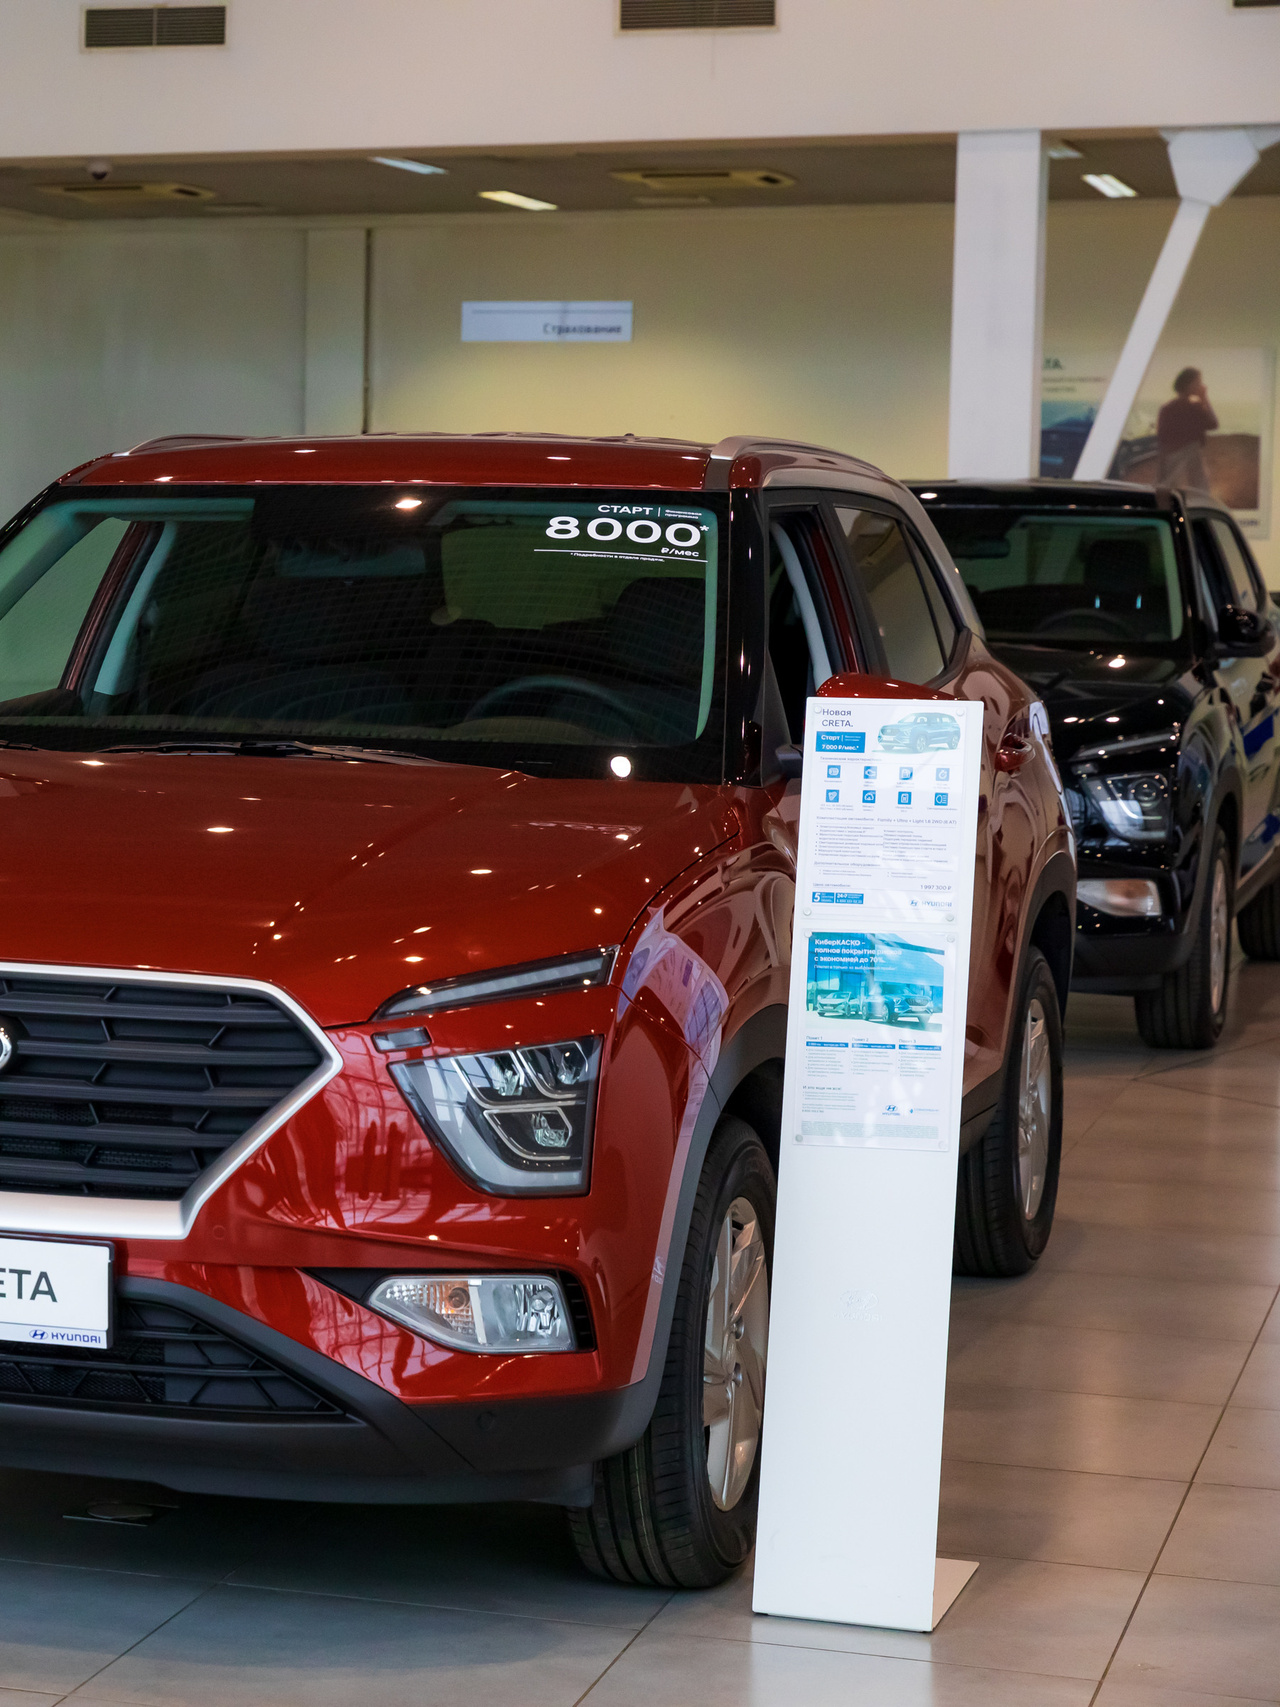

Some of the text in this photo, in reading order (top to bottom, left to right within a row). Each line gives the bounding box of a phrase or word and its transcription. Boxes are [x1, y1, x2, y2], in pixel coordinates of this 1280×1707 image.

[597, 504, 654, 515] СТАРТ
[822, 708, 852, 716] Новая
[813, 892, 821, 902] 5
[814, 939, 860, 947] КиберКАСКО
[51, 1332, 102, 1344] HYUNDAI
